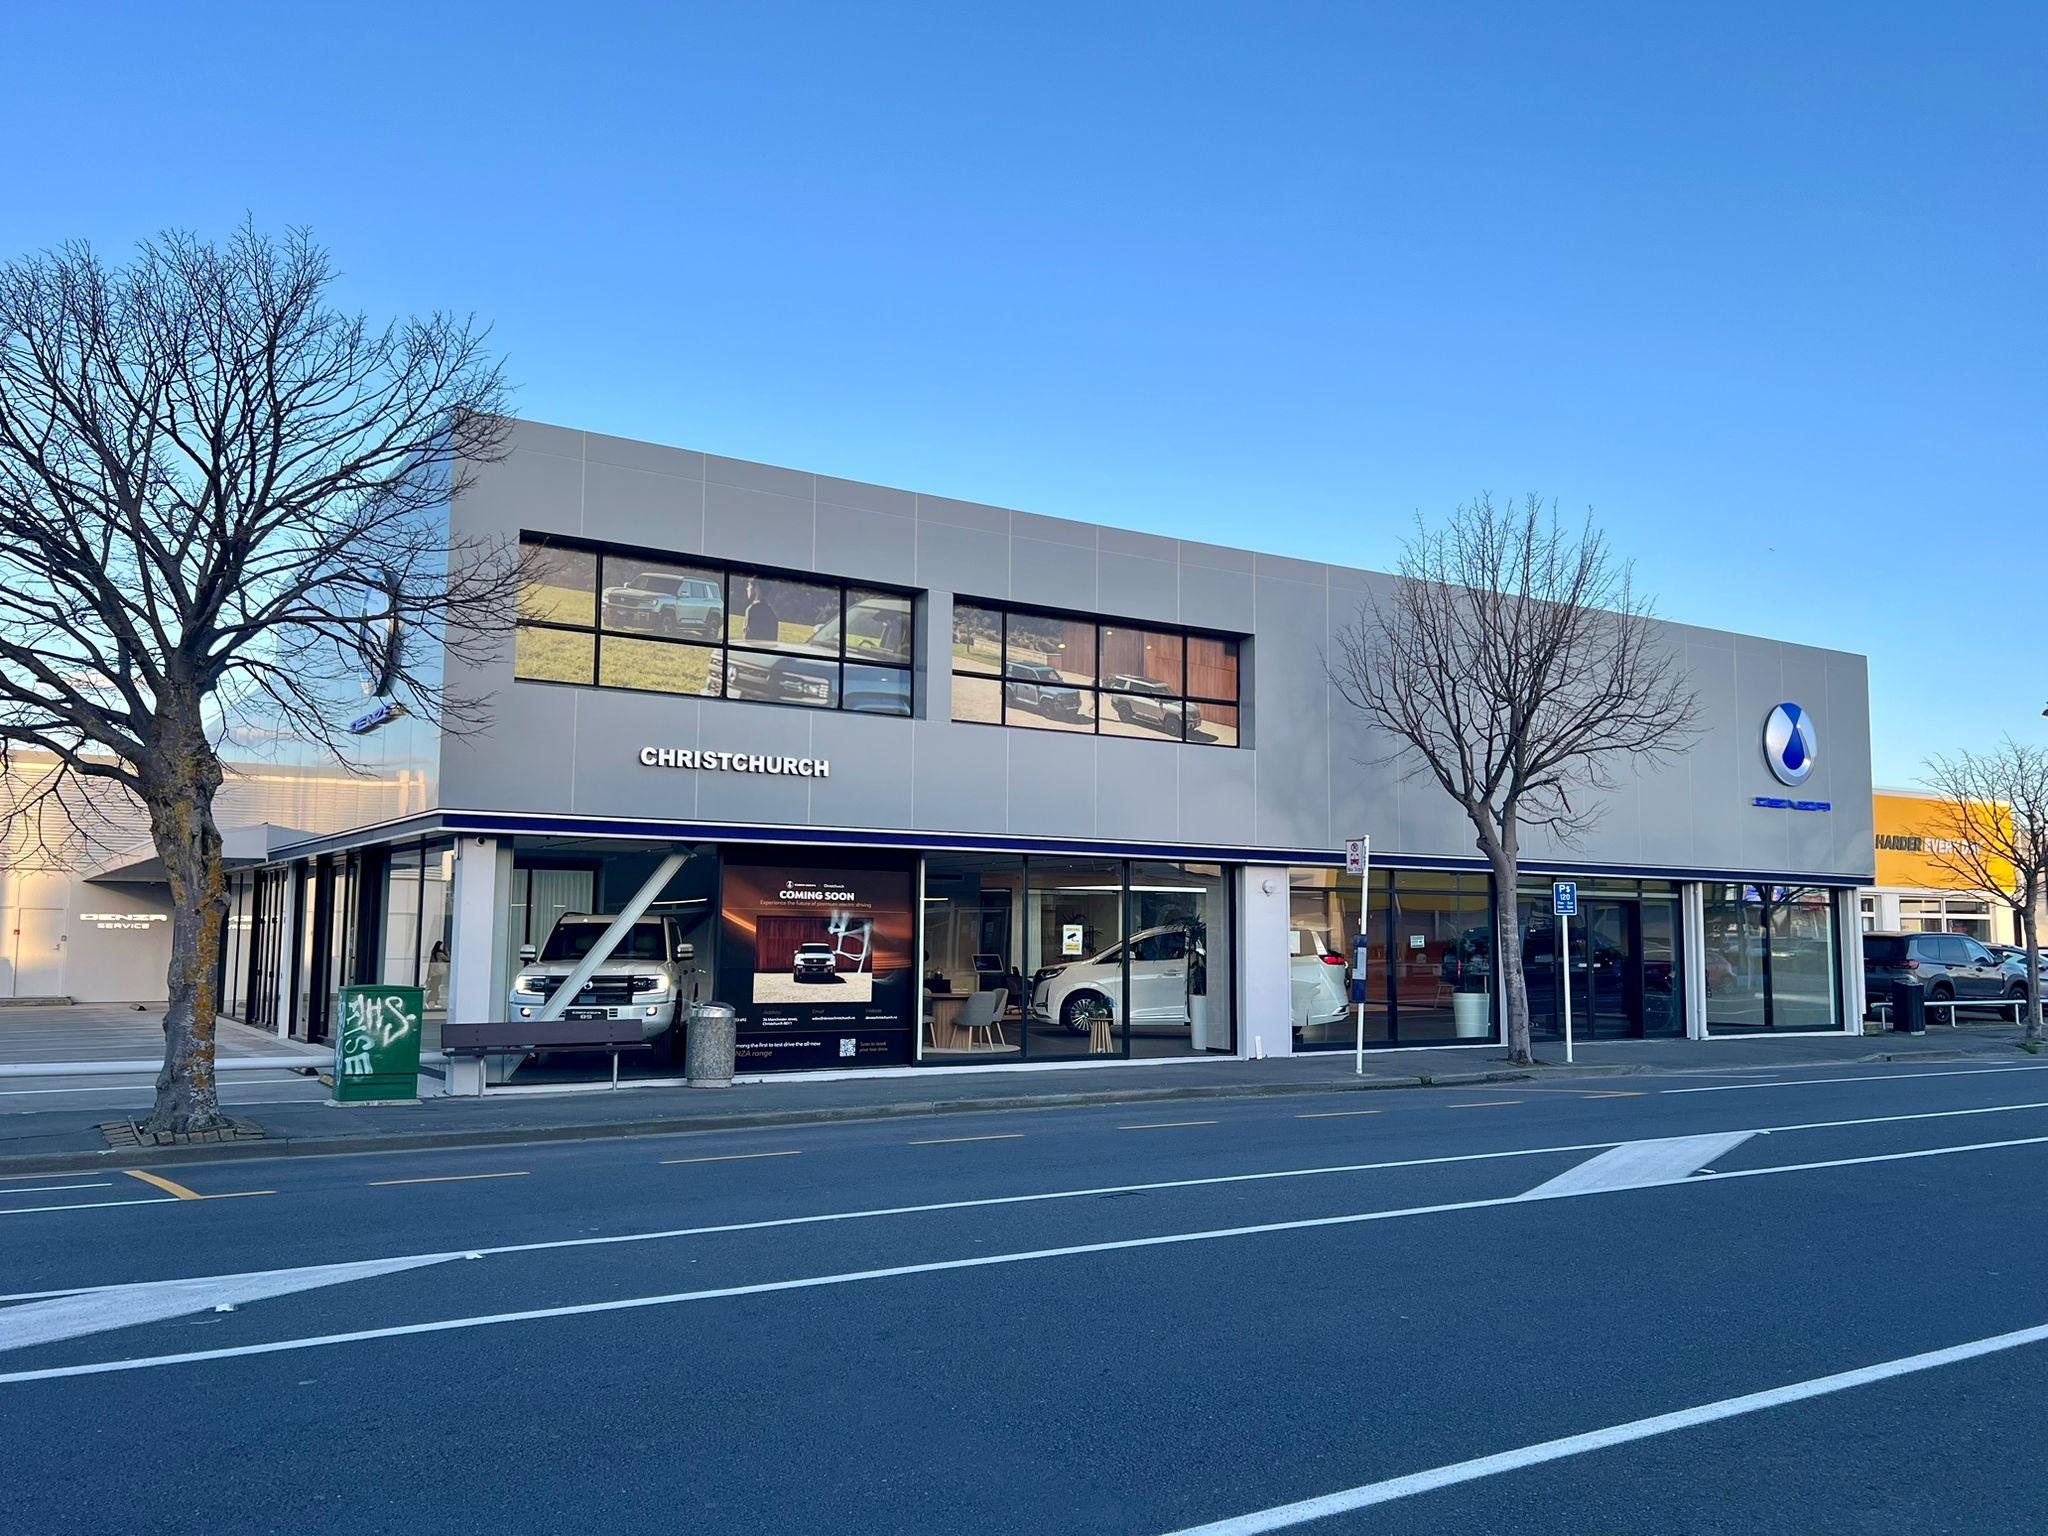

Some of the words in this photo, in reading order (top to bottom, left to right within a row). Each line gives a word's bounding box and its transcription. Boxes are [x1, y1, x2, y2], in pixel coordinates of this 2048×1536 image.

[639, 747, 830, 777] CHRISTCHURCH
[1753, 796, 1831, 811] DENZA
[1875, 834, 1921, 851] HARDER
[779, 890, 823, 900] COMING
[824, 891, 855, 901] SOON
[1559, 893, 1571, 901] 120
[80, 913, 168, 922] DENZA
[735, 1050, 752, 1058] NZA
[751, 1050, 773, 1059] range
